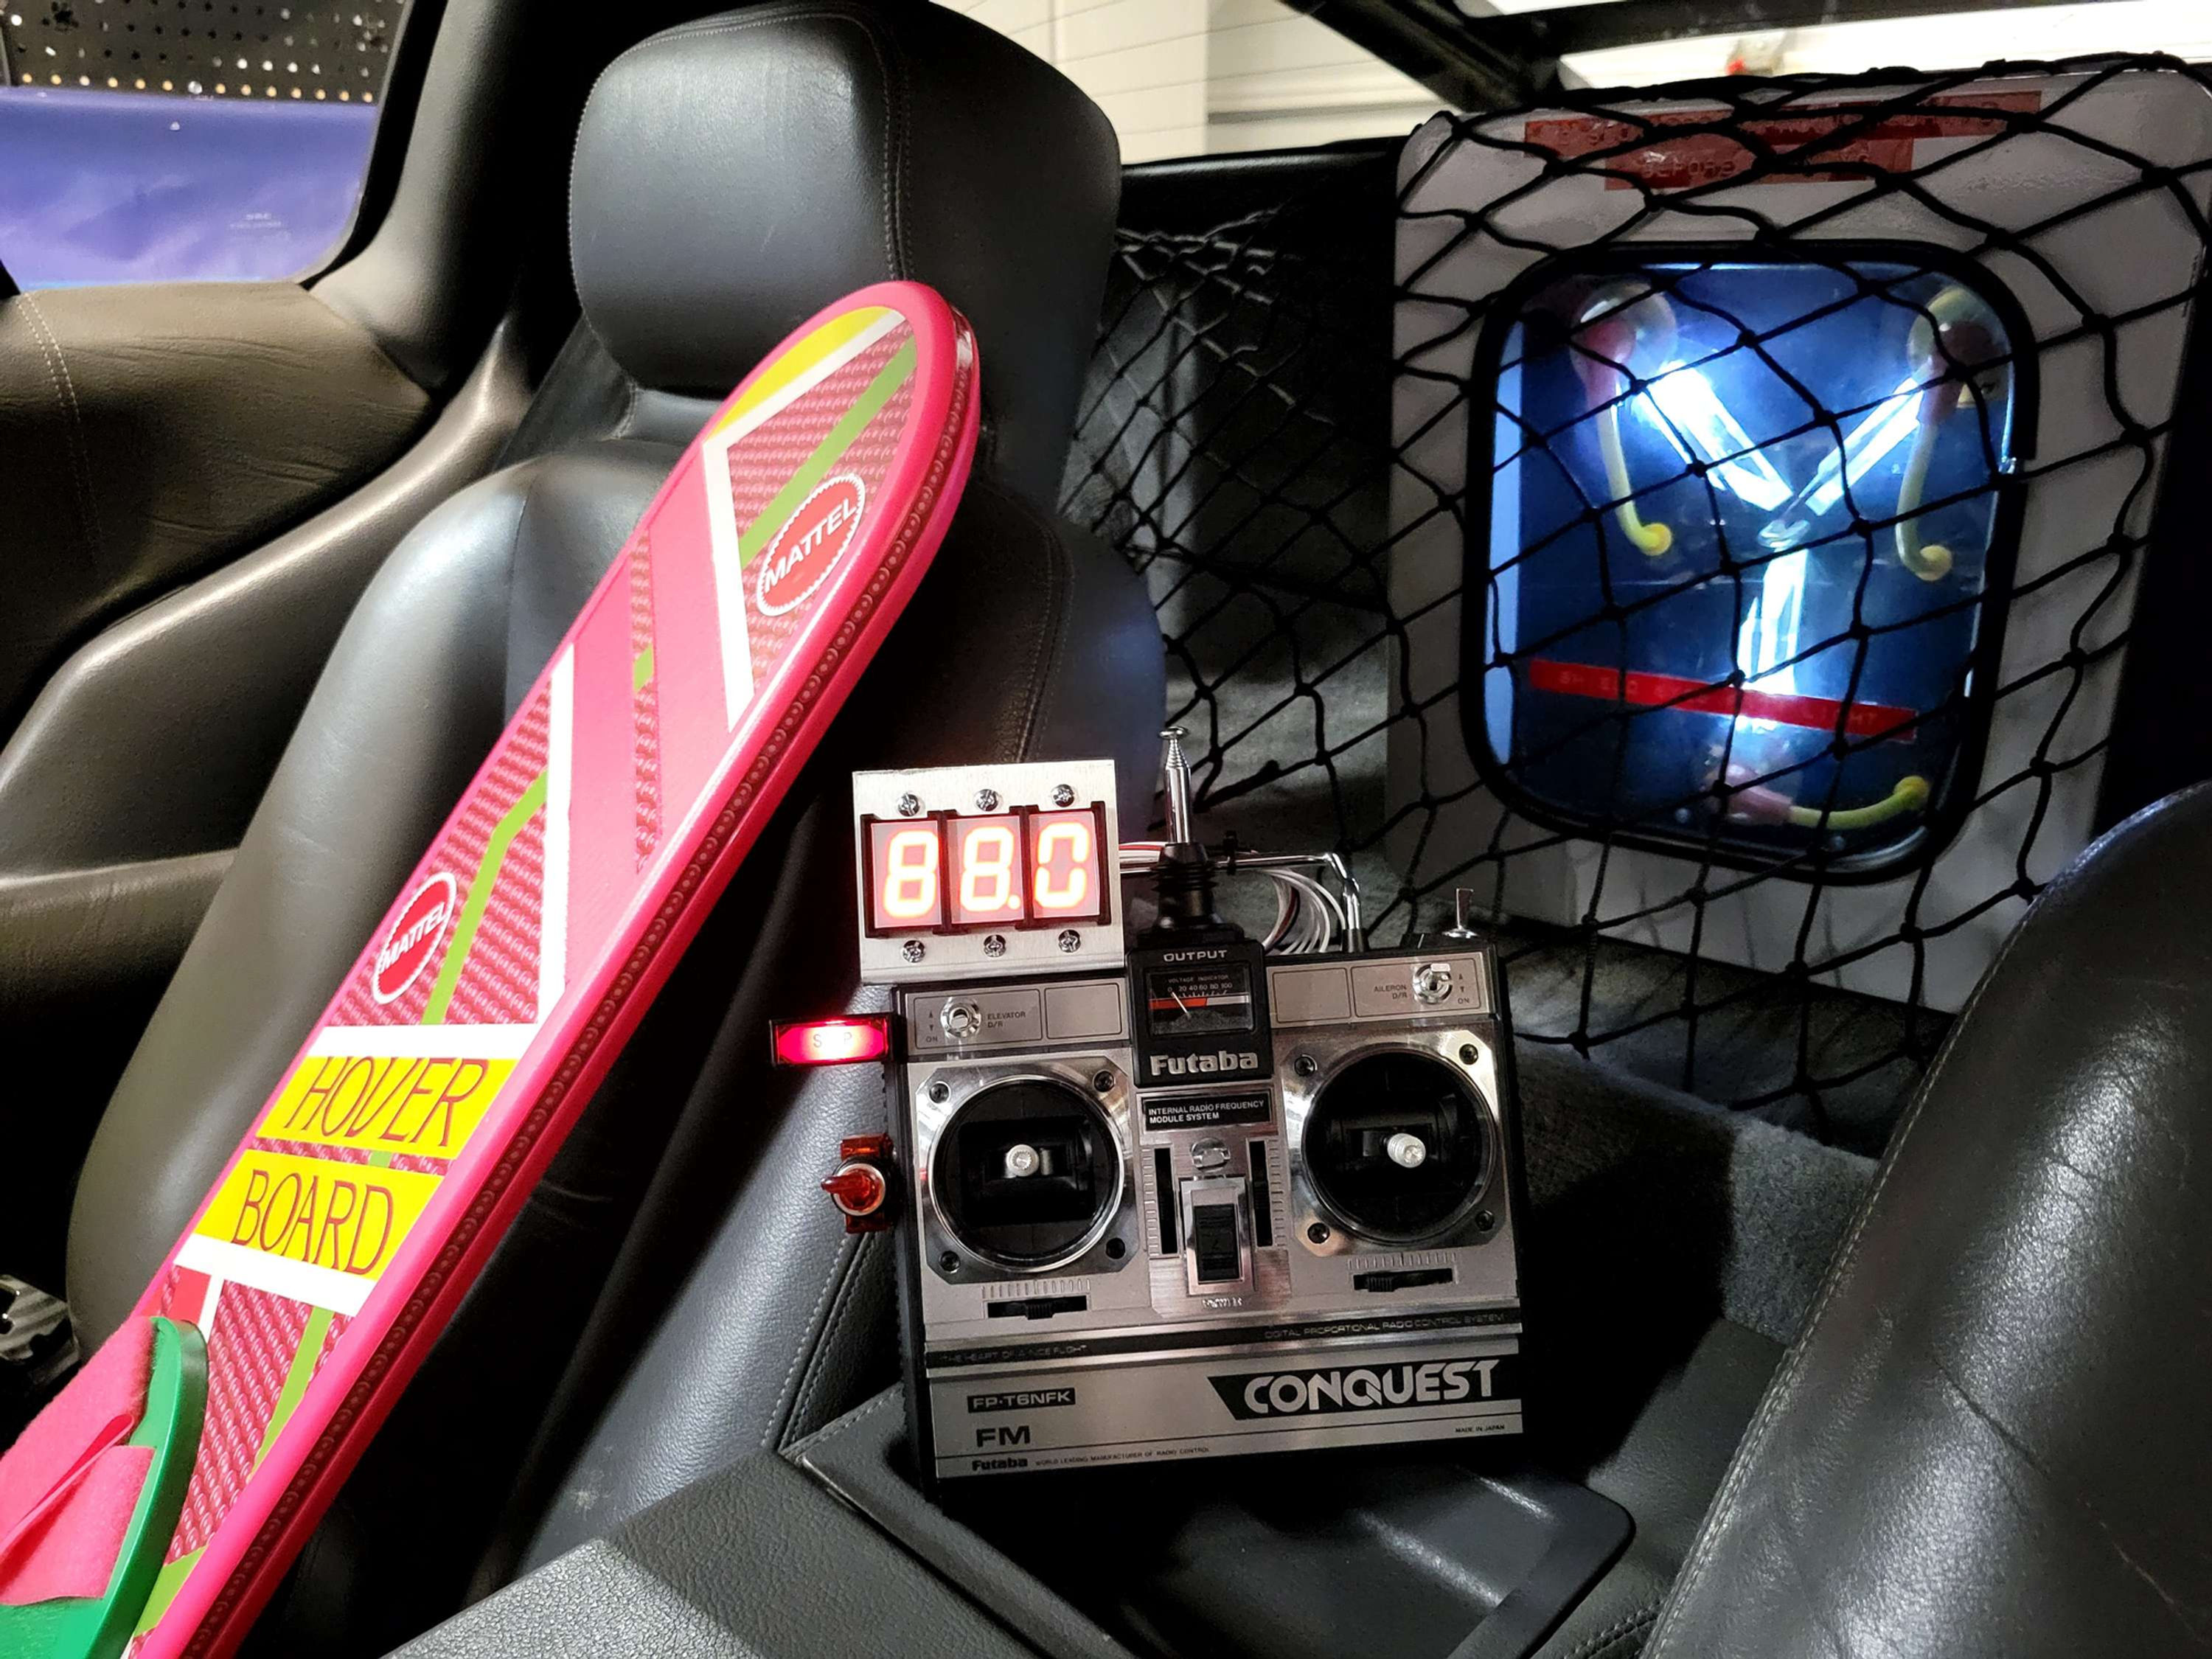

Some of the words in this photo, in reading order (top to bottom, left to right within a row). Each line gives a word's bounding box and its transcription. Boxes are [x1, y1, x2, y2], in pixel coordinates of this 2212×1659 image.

[765, 498, 856, 592] MATTEL
[379, 902, 447, 975] MATTEL
[1164, 950, 1227, 962] OUTPUT
[1374, 984, 1408, 992] AILERON
[1392, 992, 1408, 1000] D/R
[987, 1011, 1026, 1020] ELEVATOR
[987, 1020, 1004, 1029] D/R
[813, 1032, 852, 1048] SP
[1150, 1051, 1259, 1076] Futaba
[283, 1057, 489, 1147] HOVER
[1148, 1106, 1189, 1116] INTERNAL
[1189, 1104, 1214, 1113] RADIO
[1216, 1100, 1265, 1110] FREQUENCY
[1149, 1115, 1184, 1124] MODULE
[1186, 1112, 1220, 1121] SYSTEM
[232, 1169, 392, 1275] BOARD
[1264, 1329, 1301, 1339] DIGTAL
[1304, 1324, 1380, 1335] PROPORTONAL
[1382, 1320, 1413, 1328] RADO
[1414, 1317, 1461, 1326] CONTROL
[1054, 1345, 1087, 1354] FLGHT
[1245, 1360, 1500, 1413] CONQUEST
[976, 1425, 1030, 1447] FM
[972, 1457, 1028, 1471] Futaba
[1091, 1452, 1142, 1461] MANUFACTURER
